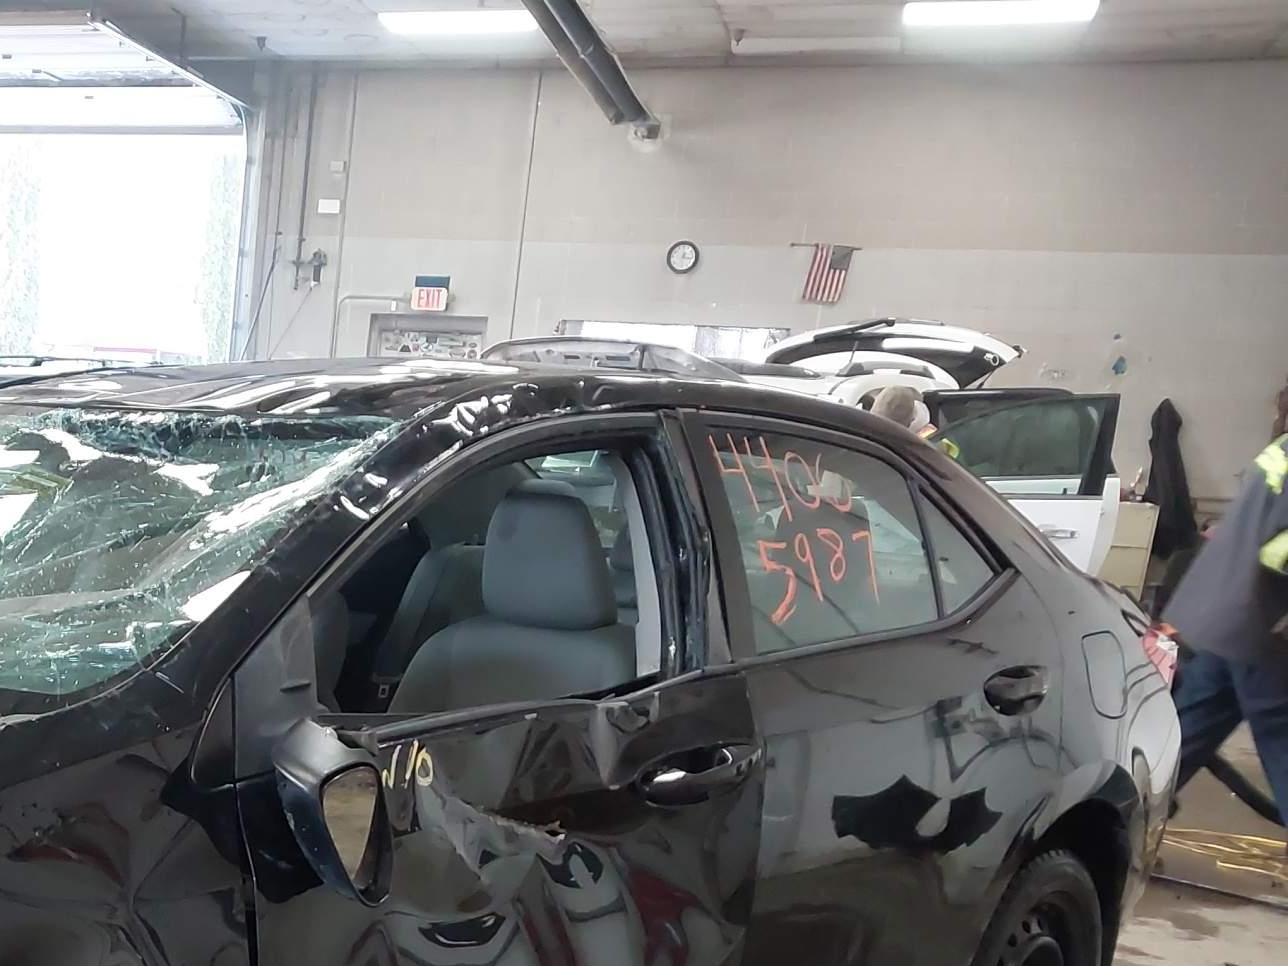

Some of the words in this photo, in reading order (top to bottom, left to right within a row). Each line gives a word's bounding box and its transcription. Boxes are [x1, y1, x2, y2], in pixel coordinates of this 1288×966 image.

[417, 288, 443, 309] EXIT
[708, 432, 852, 522] 4406
[756, 527, 880, 625] 5987
